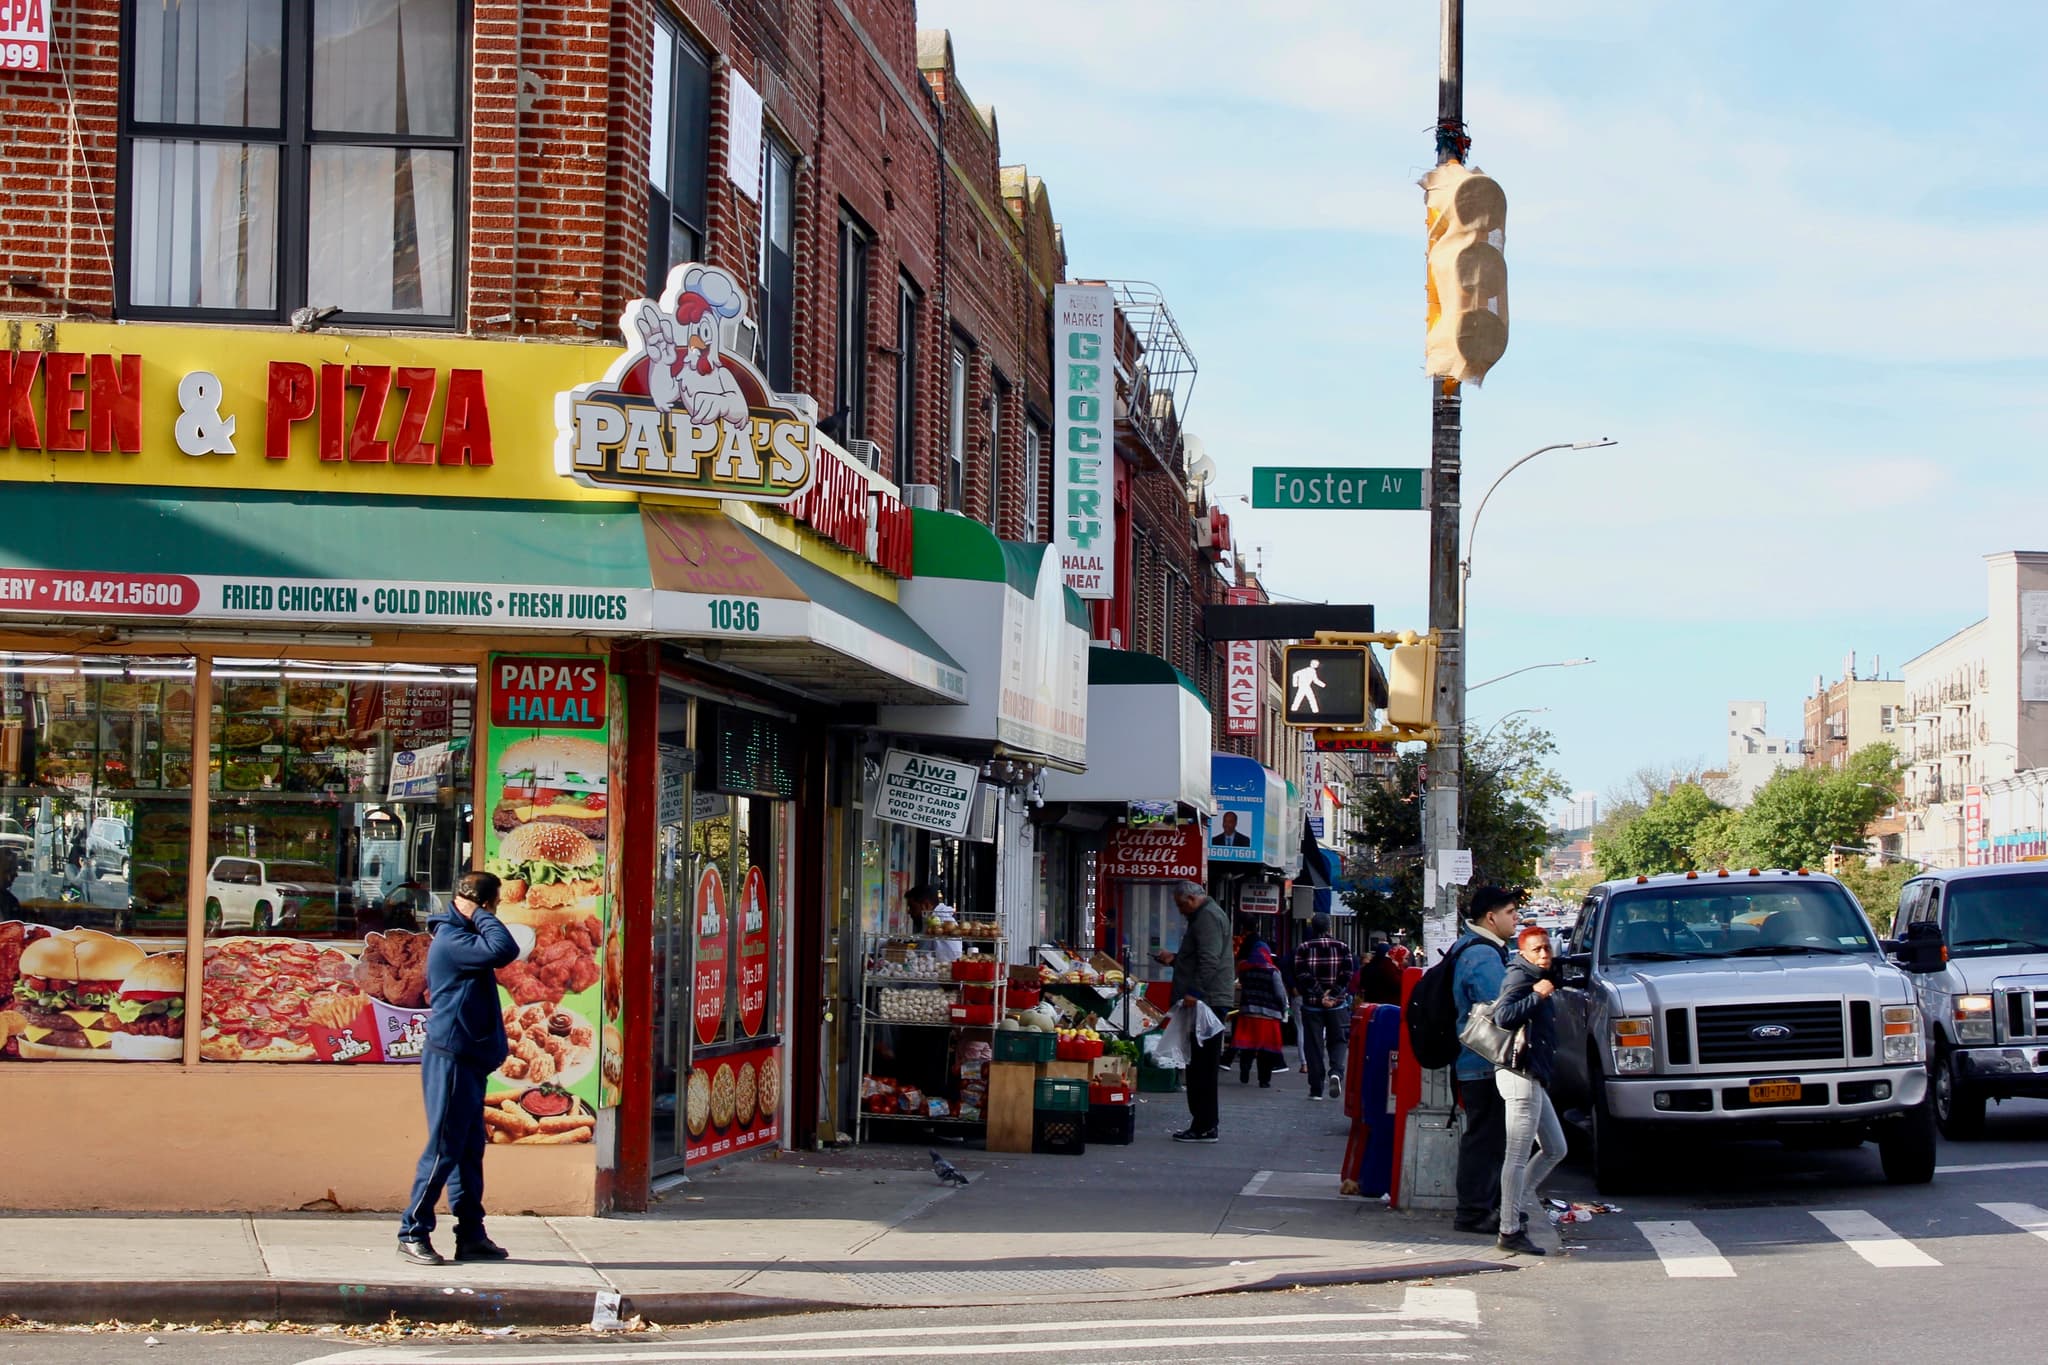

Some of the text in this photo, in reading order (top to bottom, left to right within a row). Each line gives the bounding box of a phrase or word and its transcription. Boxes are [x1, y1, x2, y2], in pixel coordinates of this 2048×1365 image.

[1063, 312, 1104, 328] MARKET
[175, 370, 237, 456] &
[265, 361, 494, 465] PIZZA
[573, 401, 811, 488] PAPA'S
[1067, 332, 1101, 549] GROCERY
[1275, 473, 1402, 504] Foster Av
[1062, 555, 1104, 571] HALAL
[52, 580, 183, 606] 718.421.5600
[1066, 574, 1101, 589] MEAT
[222, 584, 627, 620] FRIED CHICKEN COLD DRINKS FRESH JUICES
[708, 599, 760, 632] 1036
[501, 665, 597, 692] PAPA'S
[405, 688, 441, 697] Ice Cream
[508, 696, 596, 722] HALAL
[905, 758, 957, 781] Ajwa
[891, 775, 966, 799] WE ACCEPT
[888, 798, 957, 820] FOOD STAMPS
[889, 789, 960, 811] CREDIT CARDS
[890, 808, 952, 828] WIC CHECKS
[1117, 847, 1178, 863] Chilli
[1100, 863, 1198, 876] 718-859-1400
[1760, 1027, 1781, 1037] Ford
